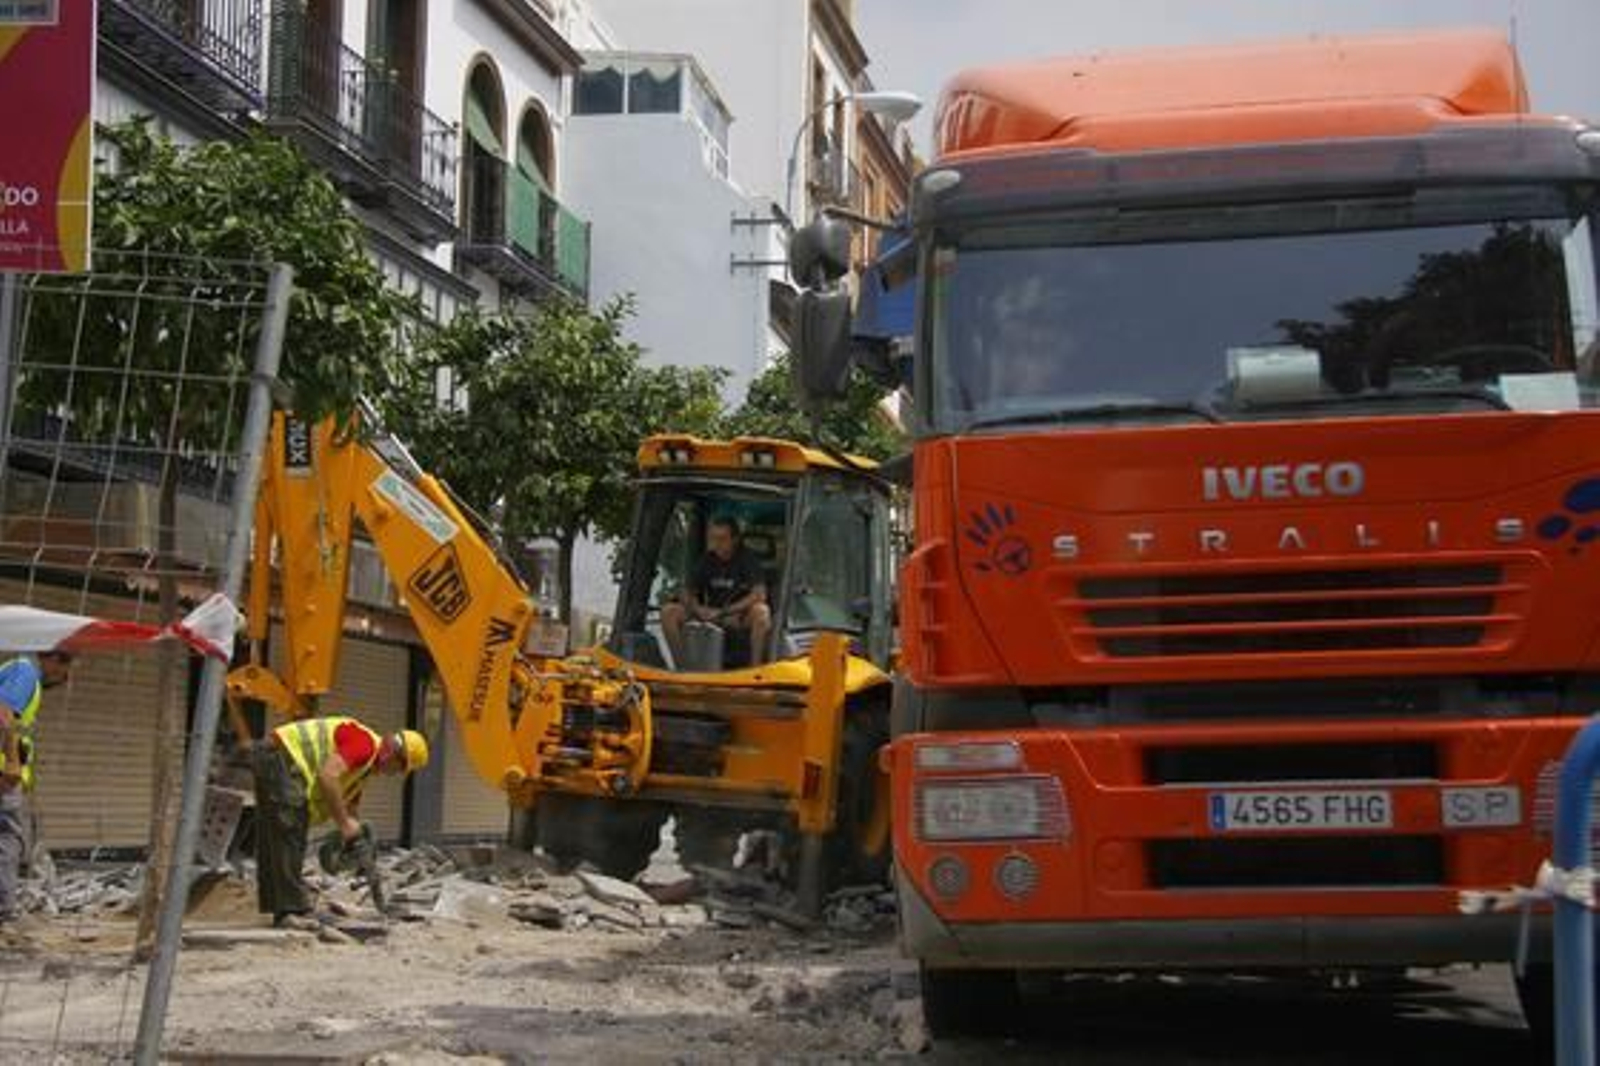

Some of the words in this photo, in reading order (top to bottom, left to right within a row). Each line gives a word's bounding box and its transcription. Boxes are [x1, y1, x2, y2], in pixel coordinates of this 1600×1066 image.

[1202, 461, 1366, 501] IVECO
[1053, 518, 1524, 557] STRALIS
[413, 551, 469, 619] JCB
[1232, 794, 1313, 824] 4565
[1323, 794, 1386, 824] FHG
[1451, 792, 1509, 822] SP
